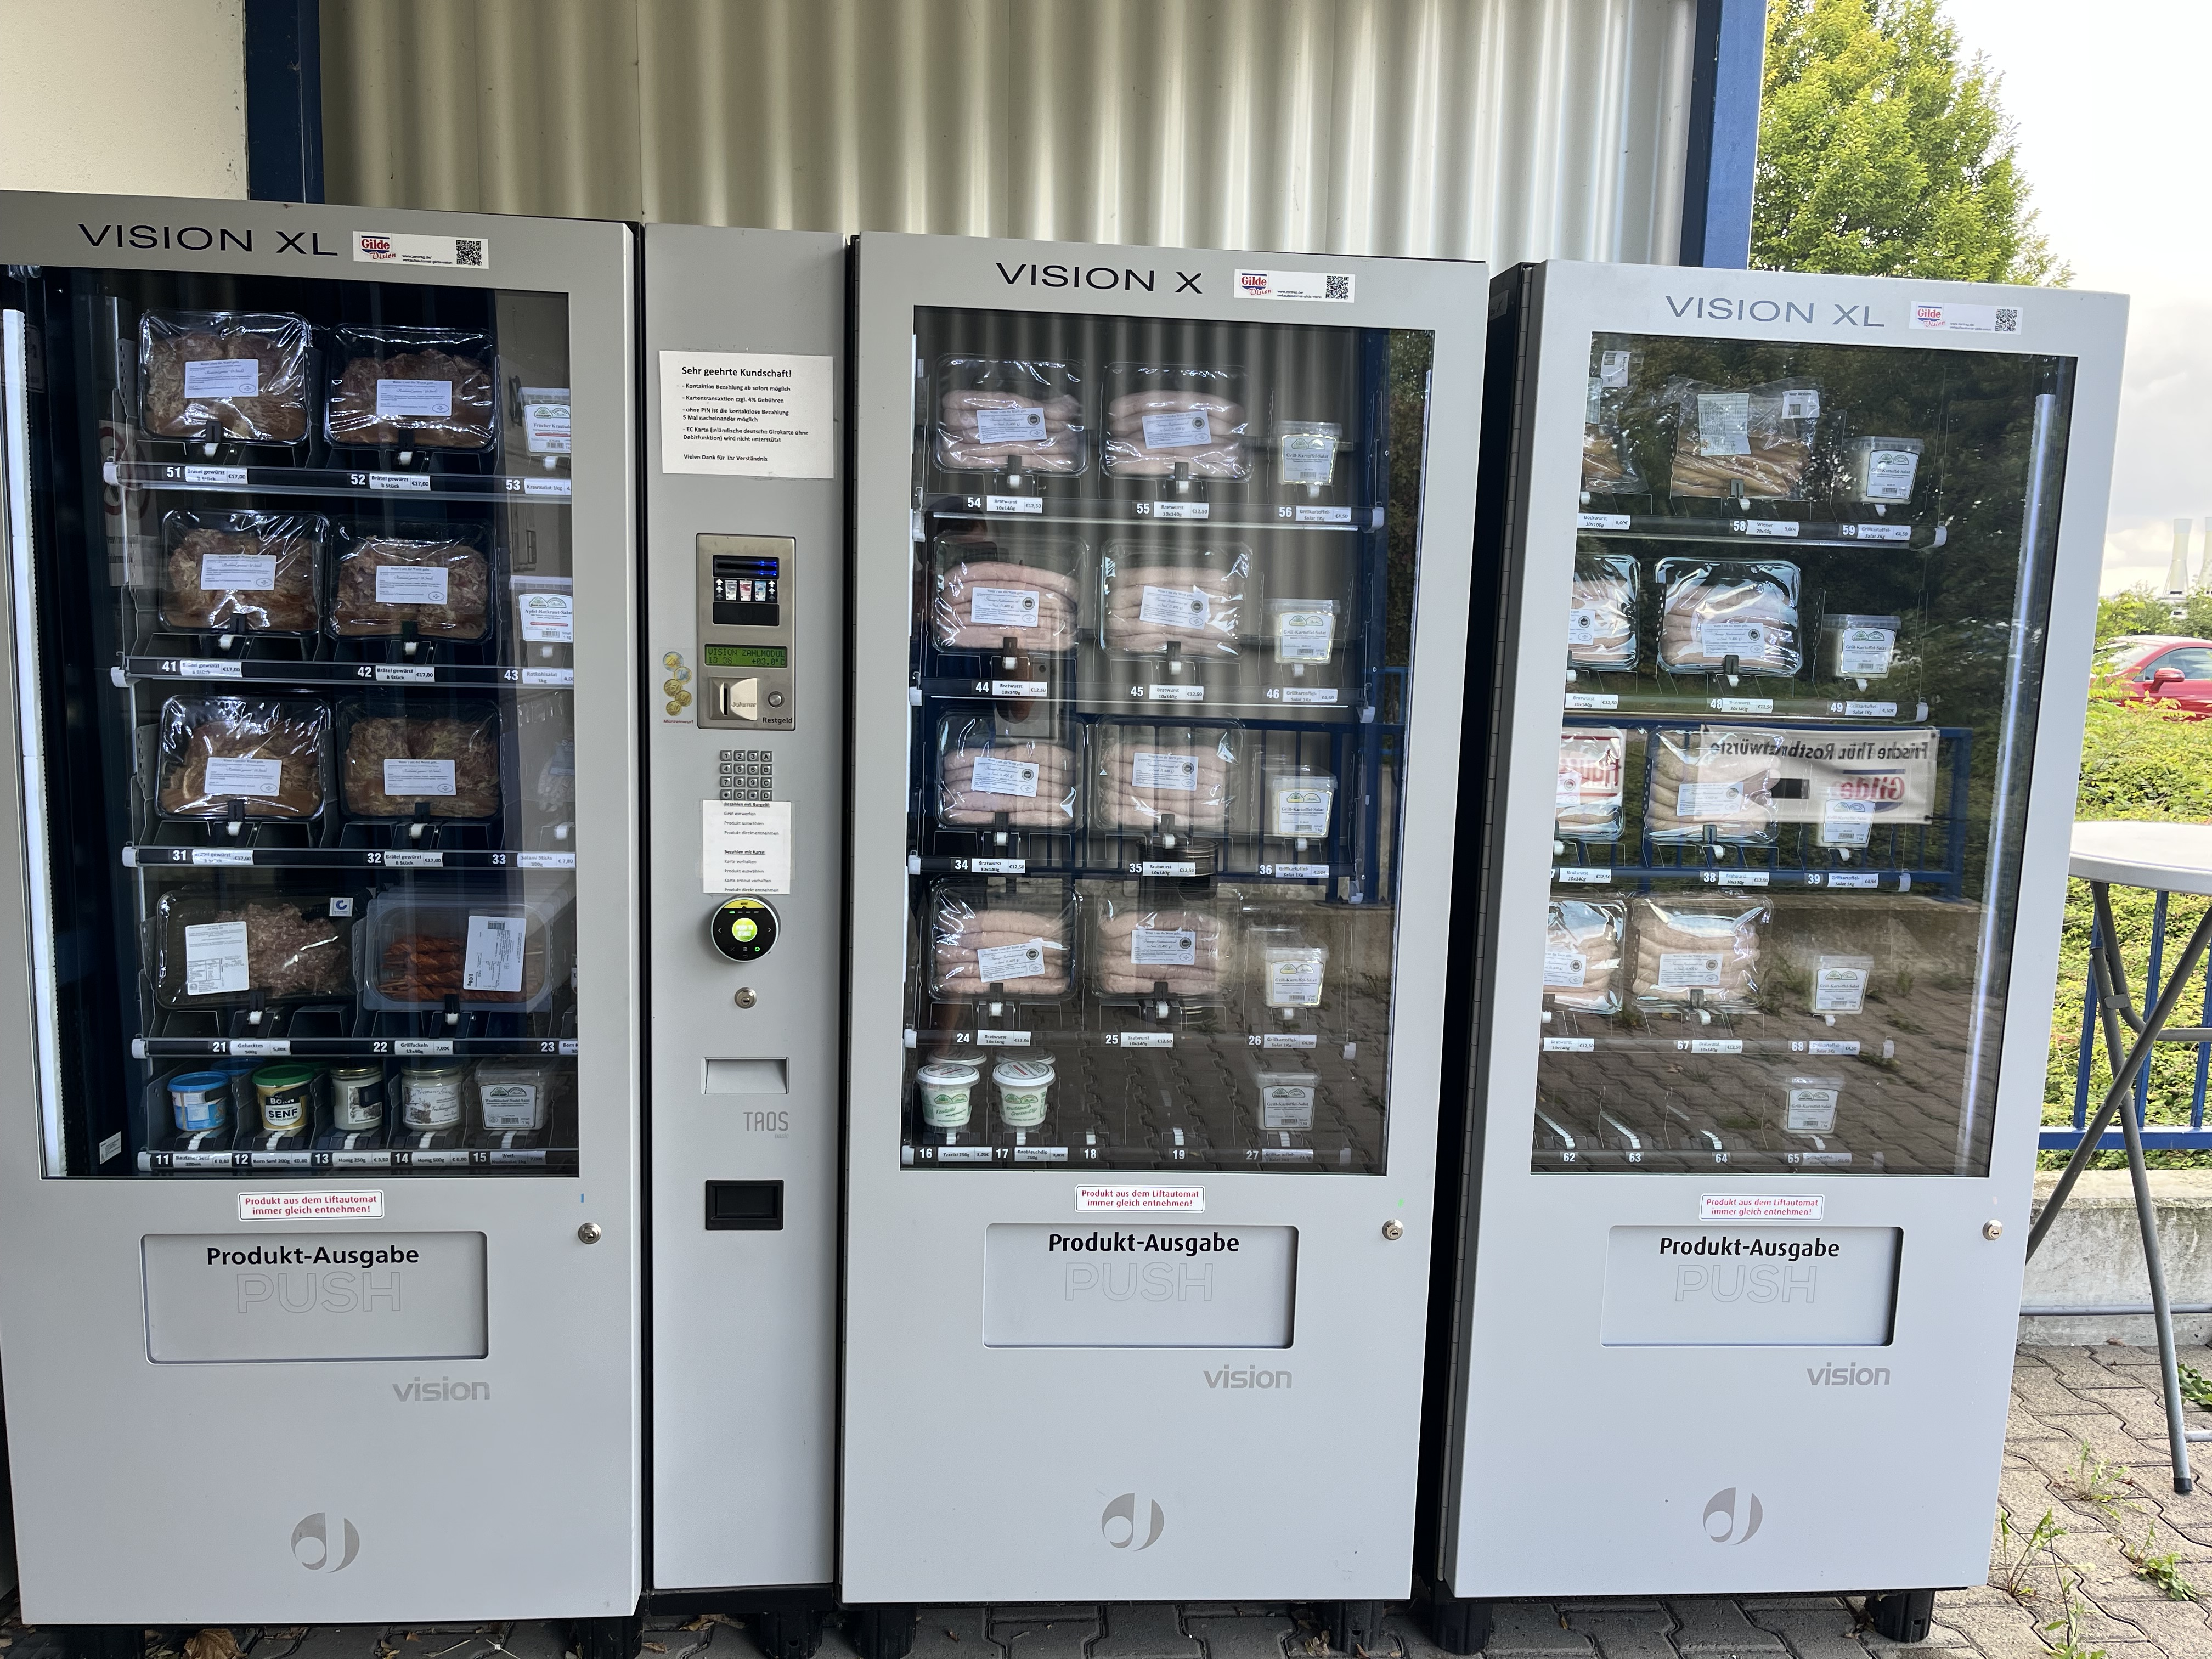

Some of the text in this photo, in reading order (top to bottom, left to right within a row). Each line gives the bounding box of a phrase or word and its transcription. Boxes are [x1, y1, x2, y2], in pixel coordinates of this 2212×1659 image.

[78, 224, 338, 256] VISION XL
[361, 239, 390, 250] Gilde
[369, 252, 396, 260] Vision
[996, 262, 1203, 294] VISION X
[1241, 276, 1267, 286] Gilde
[1665, 295, 1884, 327] VISION XL
[1917, 308, 1942, 318] Gilde
[682, 366, 792, 377] Sehr geehrte Kundschaft!
[166, 466, 181, 478] 51
[351, 473, 366, 486] 52
[506, 479, 521, 491] 53
[967, 497, 981, 508] 54
[1137, 503, 1150, 514] 55
[1279, 506, 1293, 517] 56
[1733, 521, 1746, 532] 58
[1842, 524, 1855, 535] 59
[708, 648, 785, 658] VISION ZAHLMODUL
[357, 666, 373, 678] 42
[504, 670, 518, 681] 43
[975, 682, 989, 692] 44
[1130, 686, 1144, 697] 45
[1710, 698, 1723, 709] 48
[1830, 702, 1843, 713] 49
[763, 716, 793, 725] Restgeld
[367, 853, 381, 864] 32
[492, 854, 506, 865] 33
[955, 860, 968, 870] 34
[1259, 865, 1273, 875] 36
[1703, 872, 1716, 883] 38
[1808, 873, 1820, 884] 39
[956, 1033, 970, 1043] 24
[1248, 1035, 1261, 1046] 26
[212, 1041, 226, 1052] 21
[373, 1041, 387, 1052] 22
[541, 1041, 555, 1052] 23
[1677, 1040, 1690, 1051] 67
[1792, 1041, 1804, 1052] 68
[268, 1108, 298, 1119] SENF
[743, 1111, 789, 1132] TAOS
[314, 1153, 329, 1164] 13
[394, 1153, 409, 1164] 14
[473, 1152, 487, 1163] 15
[919, 1148, 933, 1159] 16
[996, 1148, 1009, 1159] 17
[1172, 1149, 1185, 1159] 19
[1246, 1150, 1259, 1160] 27
[1629, 1153, 1641, 1163] 63
[1787, 1153, 1800, 1163] 65
[156, 1154, 169, 1165] 11
[245, 1197, 281, 1205] Produkt
[325, 1195, 377, 1204] Liftautomat
[1116, 1199, 1140, 1207] gleich
[285, 1206, 312, 1216] gleich
[1739, 1208, 1762, 1217] gleich
[1049, 1232, 1239, 1256] Produkt-Ausgabe
[1660, 1236, 1839, 1261] Produkt-Ausgabe
[207, 1245, 420, 1268] Produkt-Ausgabe
[1065, 1262, 1213, 1301] PUSH
[1675, 1264, 1817, 1303] PUSH
[236, 1271, 401, 1314] PUSH
[1203, 1364, 1292, 1389] vision
[1807, 1362, 1891, 1386] vision
[392, 1376, 490, 1403] vision
